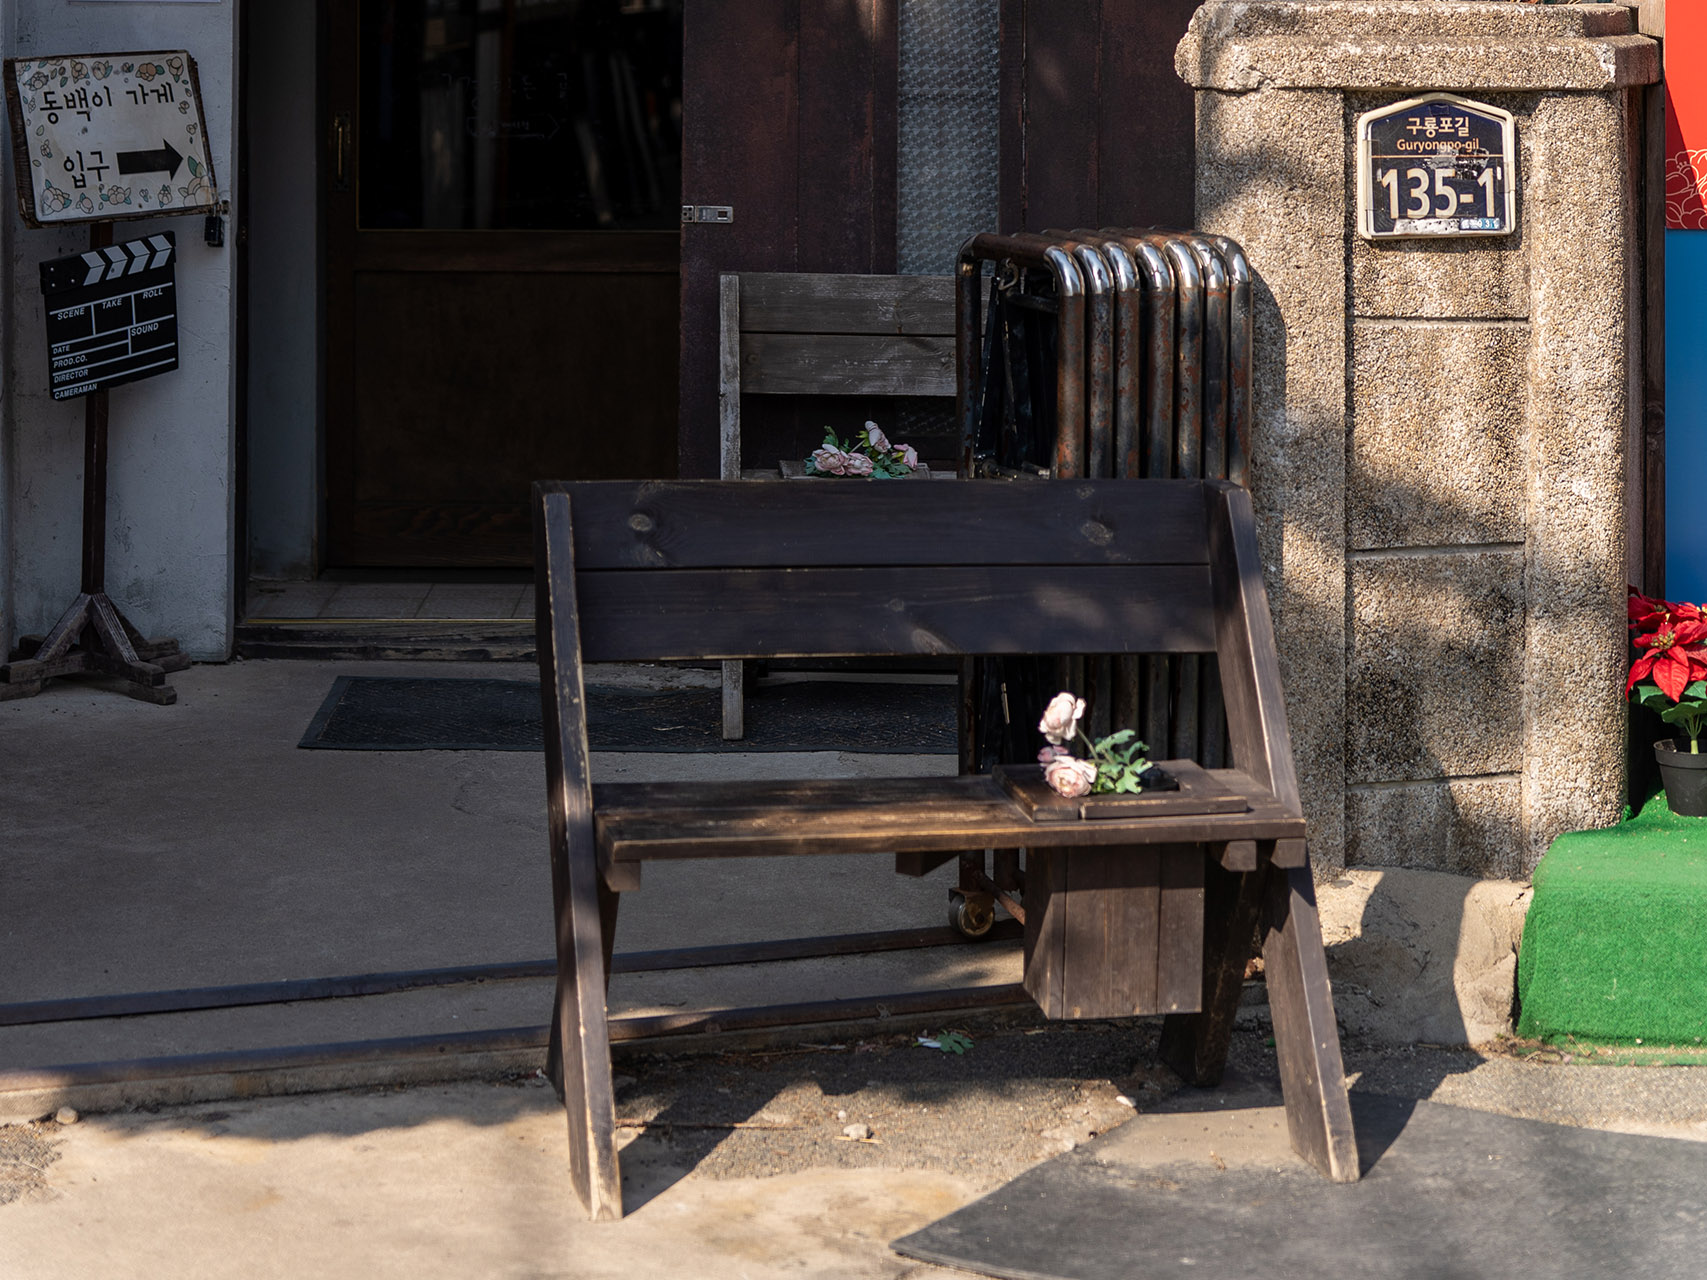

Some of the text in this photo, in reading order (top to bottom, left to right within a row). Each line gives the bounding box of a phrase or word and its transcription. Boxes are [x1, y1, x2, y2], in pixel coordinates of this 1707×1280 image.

[39, 81, 175, 126] 동백이 가게
[1406, 116, 1470, 138] 구룡포길
[1396, 138, 1479, 153] Guryongpo-gil
[63, 150, 110, 189] 입구
[1381, 167, 1495, 219] 135-1
[142, 288, 163, 299] ROLL
[102, 298, 122, 309] TAKE
[57, 307, 85, 320] SCENE
[131, 322, 159, 336] SOUND
[53, 345, 70, 354] DATE
[53, 355, 88, 368] PROD.CO.
[54, 369, 89, 383] DIRECTOR
[54, 383, 98, 400] CAMERAMAN
